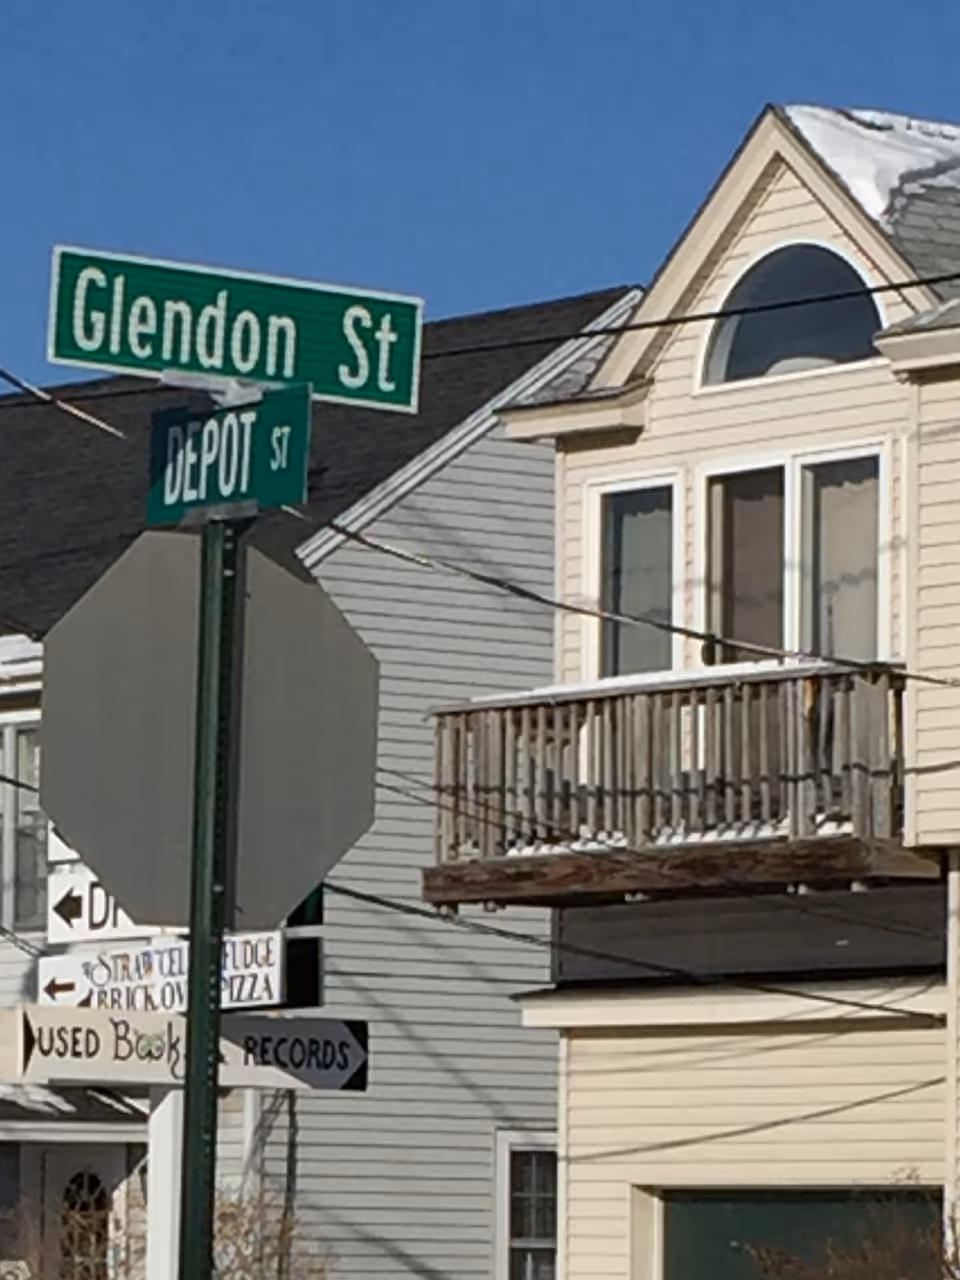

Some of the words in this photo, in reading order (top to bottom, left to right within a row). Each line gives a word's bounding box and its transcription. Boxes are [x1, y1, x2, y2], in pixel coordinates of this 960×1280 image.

[72, 266, 297, 378] Glendon
[337, 305, 398, 393] St
[163, 411, 257, 505] DEPOT
[269, 426, 292, 471] ST
[37, 1026, 100, 1059] USED
[111, 1017, 186, 1080] Book
[243, 1034, 351, 1071] RECORDS
